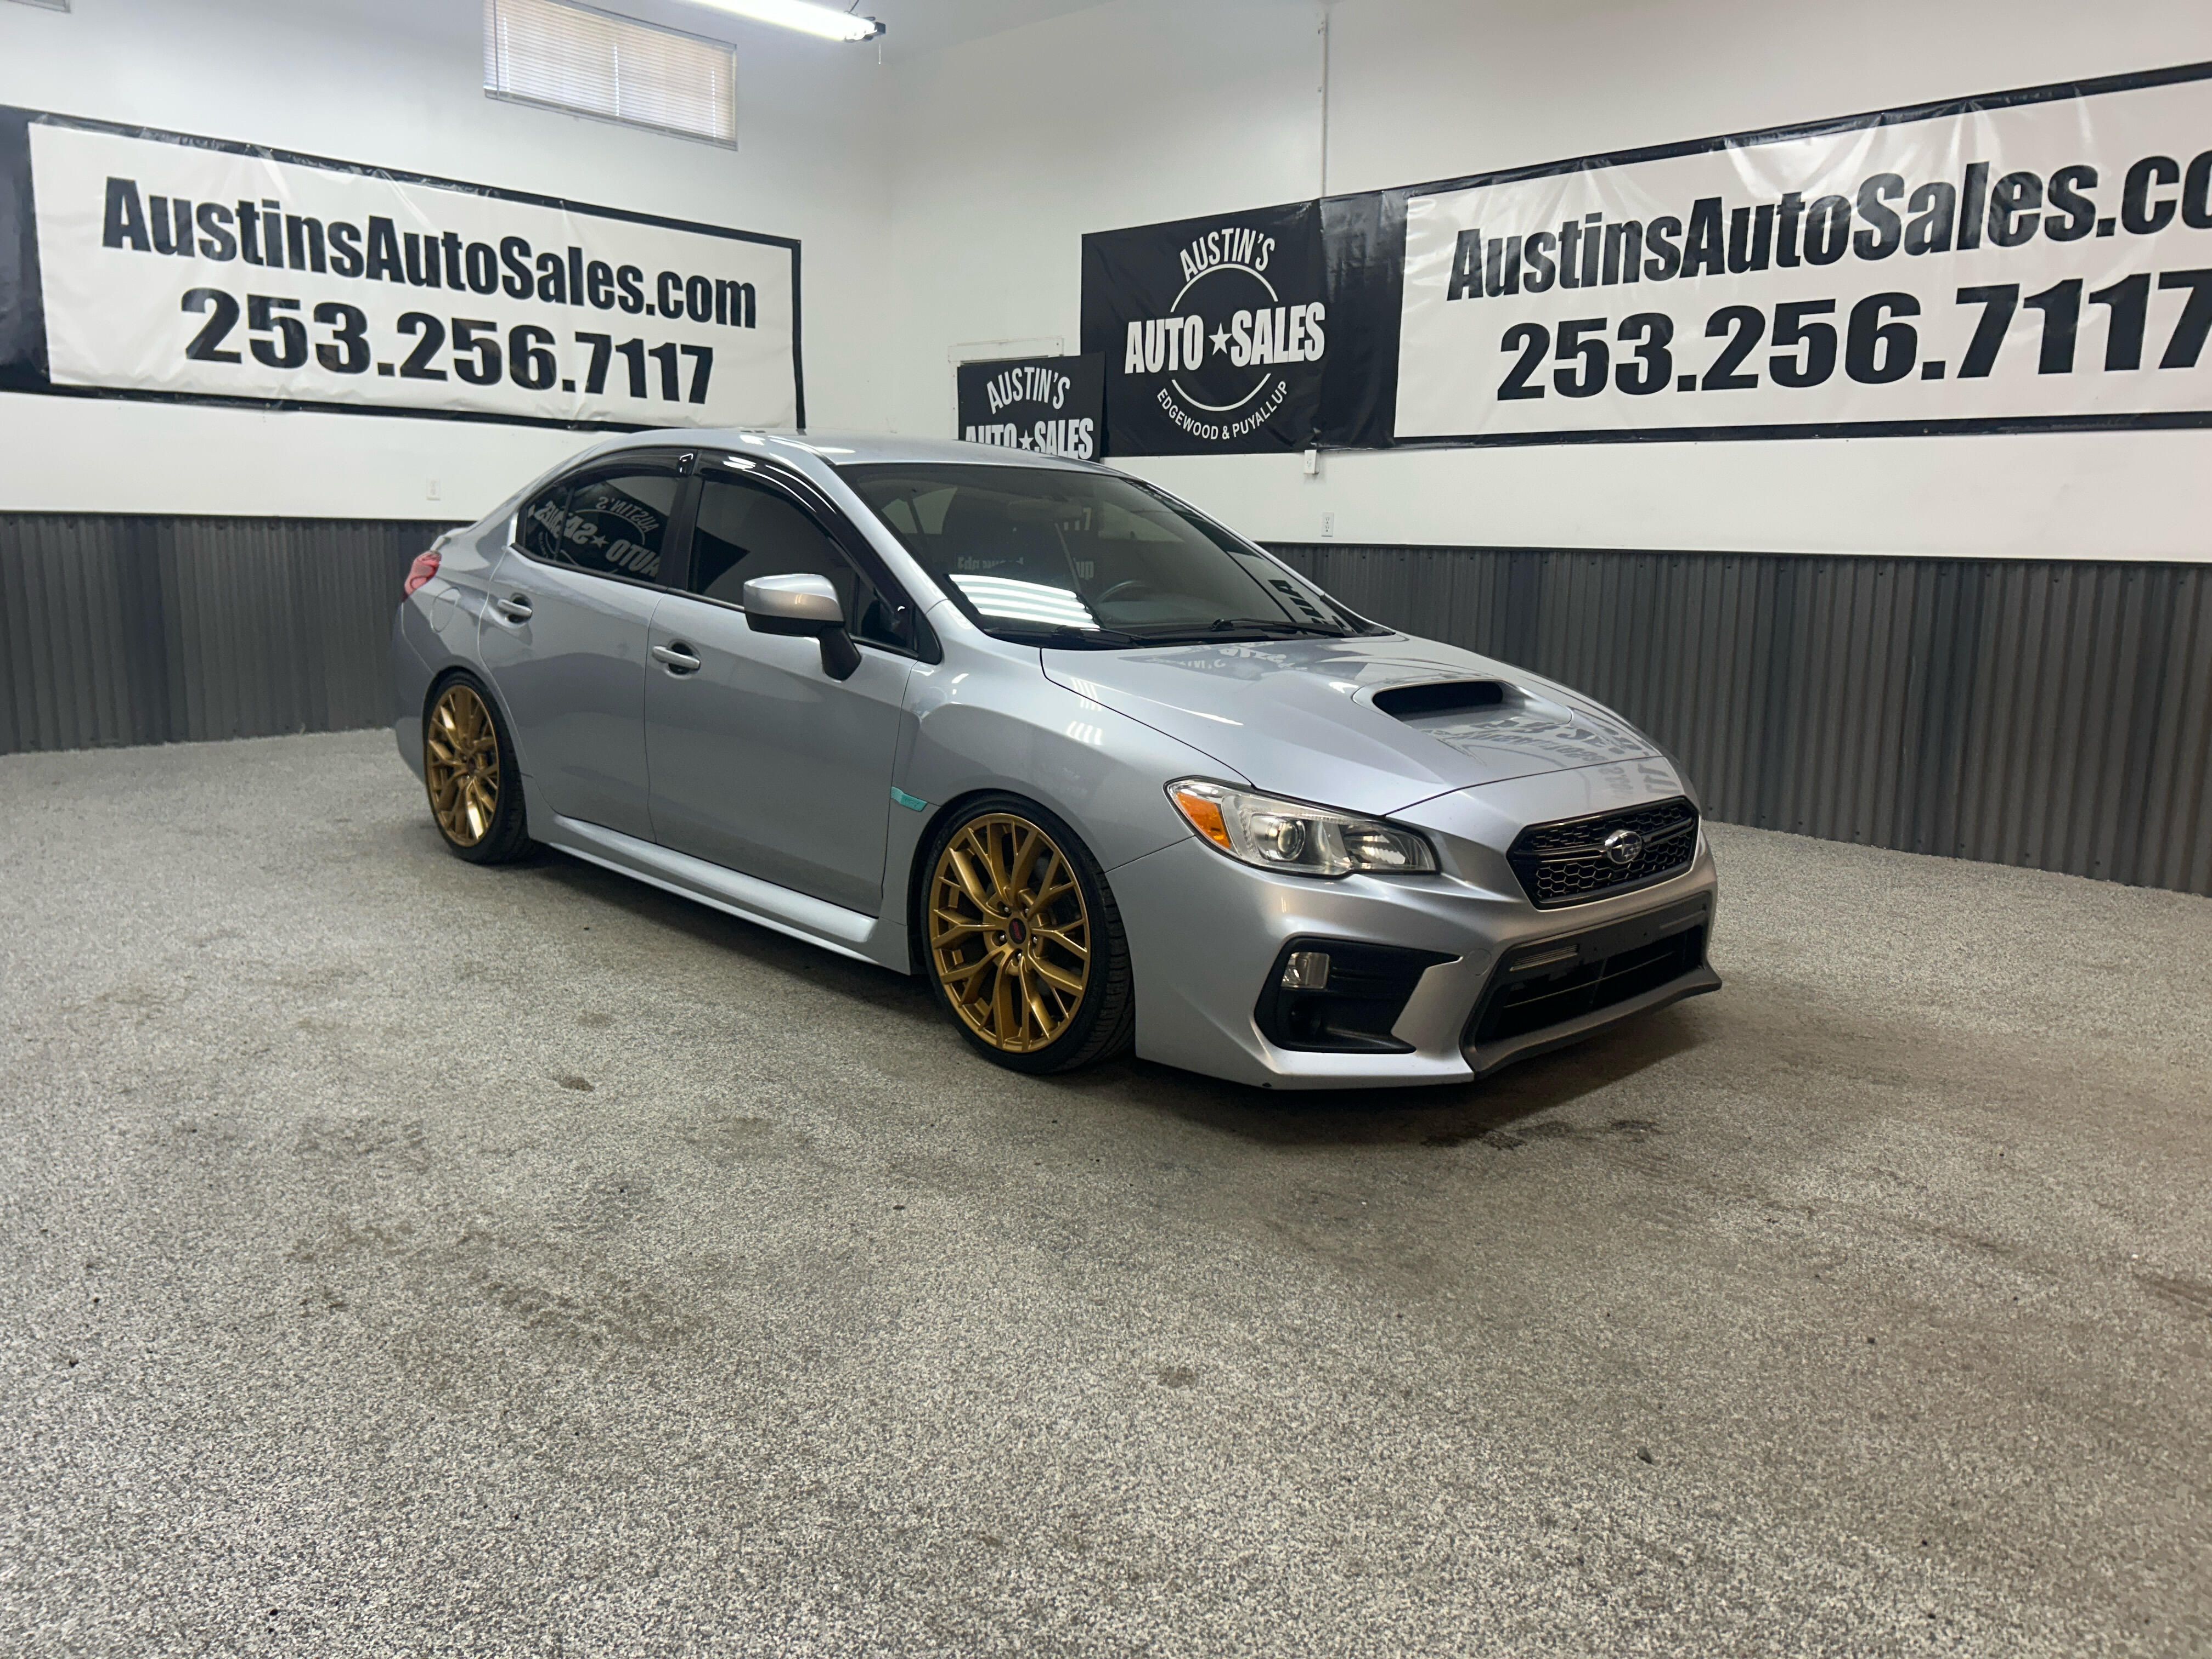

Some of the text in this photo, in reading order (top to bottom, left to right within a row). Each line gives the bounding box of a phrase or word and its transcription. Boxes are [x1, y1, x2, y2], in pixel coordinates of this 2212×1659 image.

[103, 177, 757, 329] AustinsAutoSales.com
[1180, 228, 1276, 283] AUSTIN'S
[181, 288, 714, 404] 253.256.7117
[1125, 302, 1325, 374] AUTO SALES
[1497, 269, 2212, 401] 253.256.7117
[986, 366, 1070, 414] AUSTIN'S
[1157, 381, 1288, 440] EDGEWOOD & PUYALLUP
[1034, 417, 1093, 460] SALES
